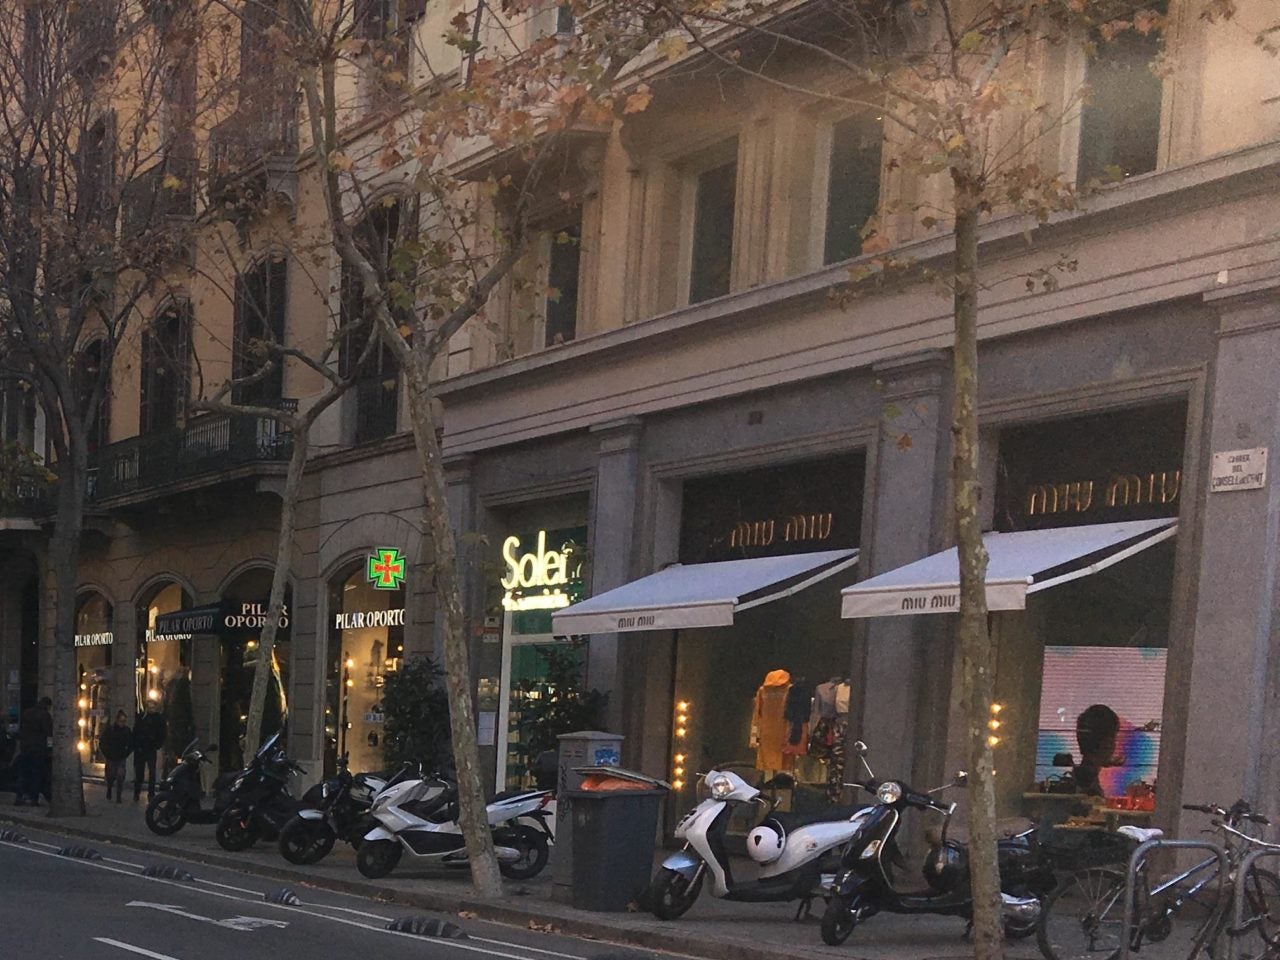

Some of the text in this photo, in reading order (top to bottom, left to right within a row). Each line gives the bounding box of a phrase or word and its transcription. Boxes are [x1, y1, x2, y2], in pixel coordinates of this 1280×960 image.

[242, 603, 288, 615] PILR
[224, 615, 289, 628] OPORO
[335, 612, 365, 629] PILAR
[74, 631, 114, 647] PILAR OPORTO
